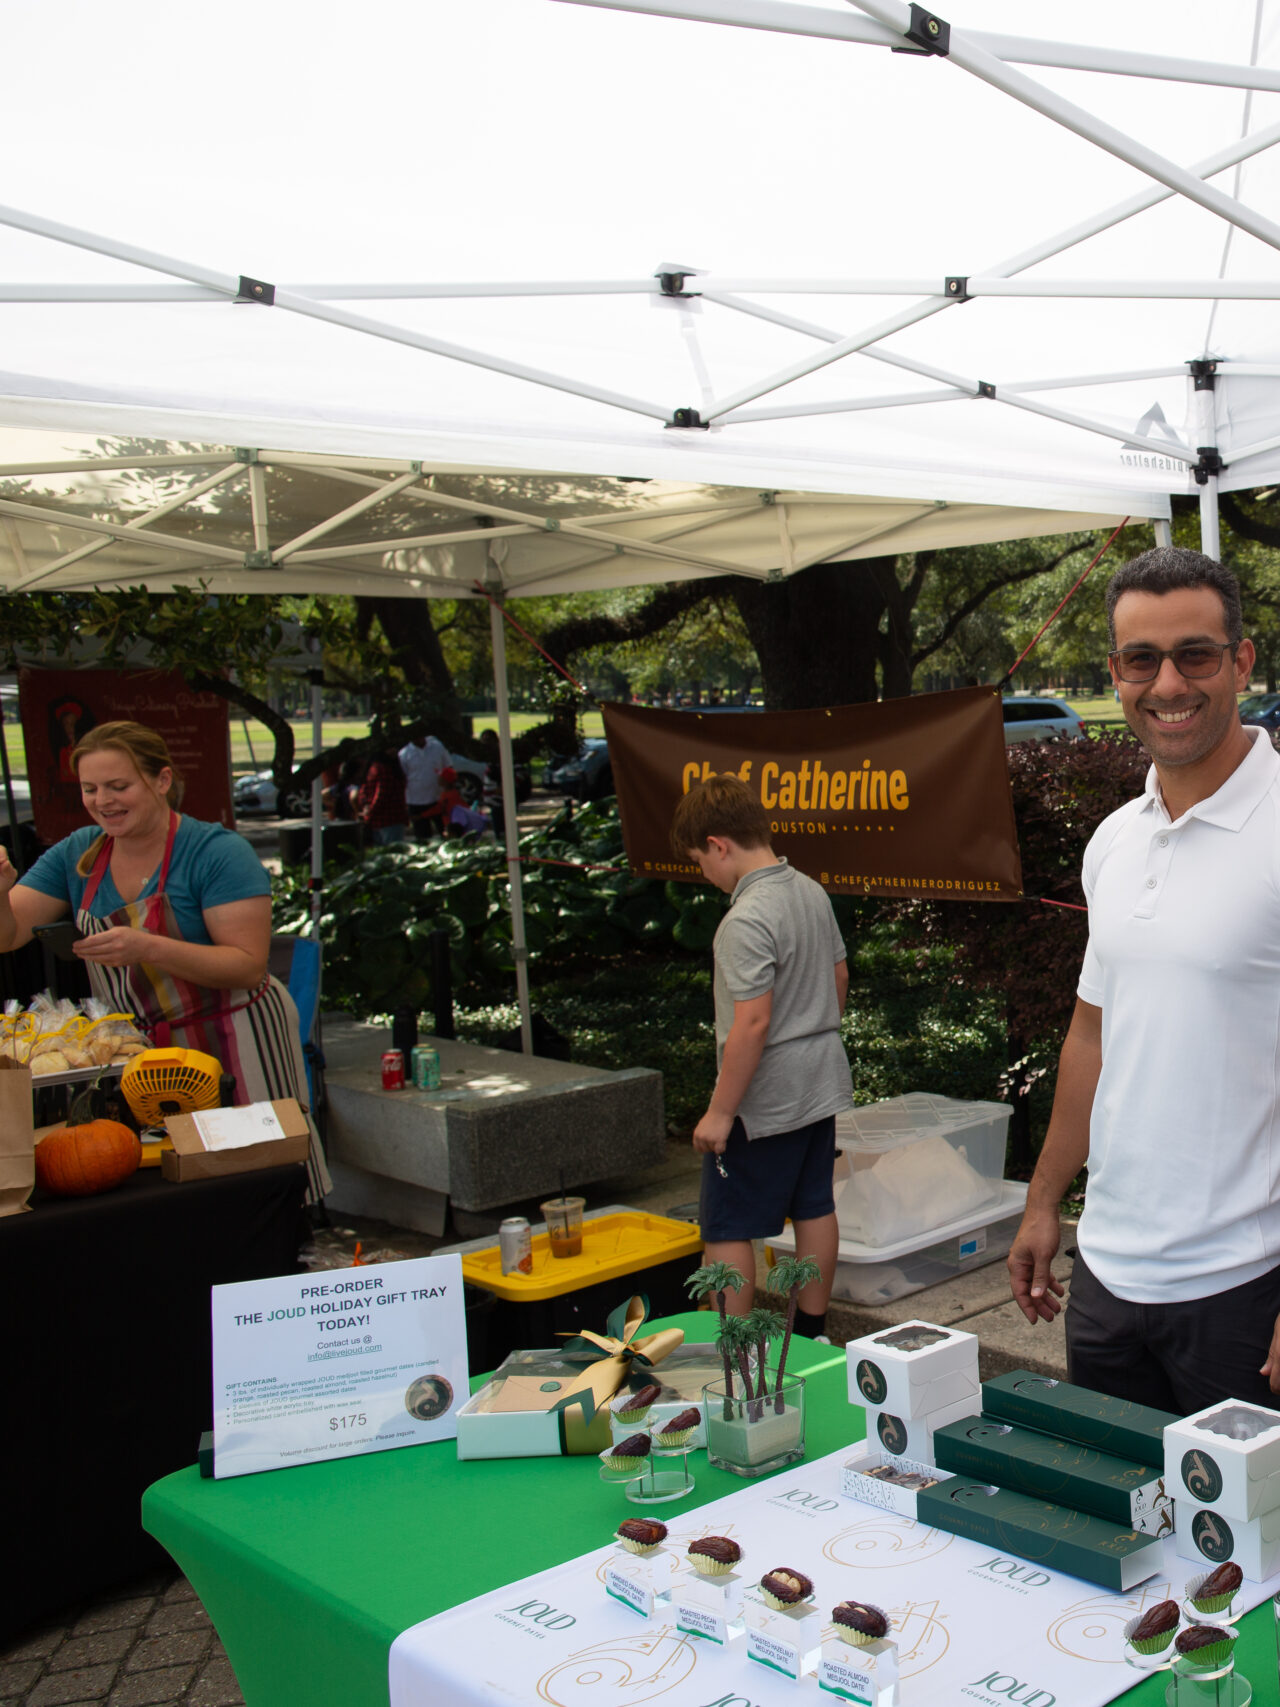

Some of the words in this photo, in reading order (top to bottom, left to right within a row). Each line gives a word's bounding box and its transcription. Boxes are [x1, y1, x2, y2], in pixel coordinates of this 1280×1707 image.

[682, 760, 753, 797] Cf
[760, 759, 910, 811] Catherine
[771, 821, 827, 834] OUSTON
[655, 862, 701, 875] CHEFCATH
[834, 874, 1001, 892] CHEFCATHERINERODRIGUEZ
[301, 1278, 384, 1299] PRE-ORDER
[234, 1312, 263, 1326] THE
[267, 1306, 306, 1322] JOUD
[311, 1297, 372, 1315] HOLIDAY
[377, 1291, 407, 1306] GIFT
[411, 1286, 447, 1301] TRAY
[317, 1314, 370, 1332] TODAY!
[317, 1338, 348, 1350] Contact
[351, 1336, 361, 1345] us
[363, 1334, 373, 1345] @
[307, 1343, 383, 1362] info@livejoud.com
[329, 1413, 367, 1431] $175
[773, 1488, 839, 1511] JOUD
[974, 1557, 1051, 1586] JOUD
[613, 1581, 631, 1597] MEDJOOL
[631, 1593, 643, 1605] DATE
[628, 1581, 646, 1599] ORANGE
[504, 1599, 577, 1630] JOUD
[679, 1607, 701, 1620] ROASTED
[701, 1614, 717, 1625] PECAN
[681, 1616, 703, 1628] MEDJOOL
[704, 1622, 716, 1633] DATE
[750, 1633, 771, 1648] ROASTED
[771, 1643, 794, 1659] HAZELNUT
[755, 1642, 776, 1658] MEDJOOL
[776, 1653, 789, 1664] DATE
[823, 1662, 847, 1677] ROASTED
[847, 1671, 870, 1685] ALMOND
[827, 1672, 850, 1687] MEDJOOL
[851, 1682, 865, 1692] DATE
[968, 1670, 1056, 1707] JOUD
